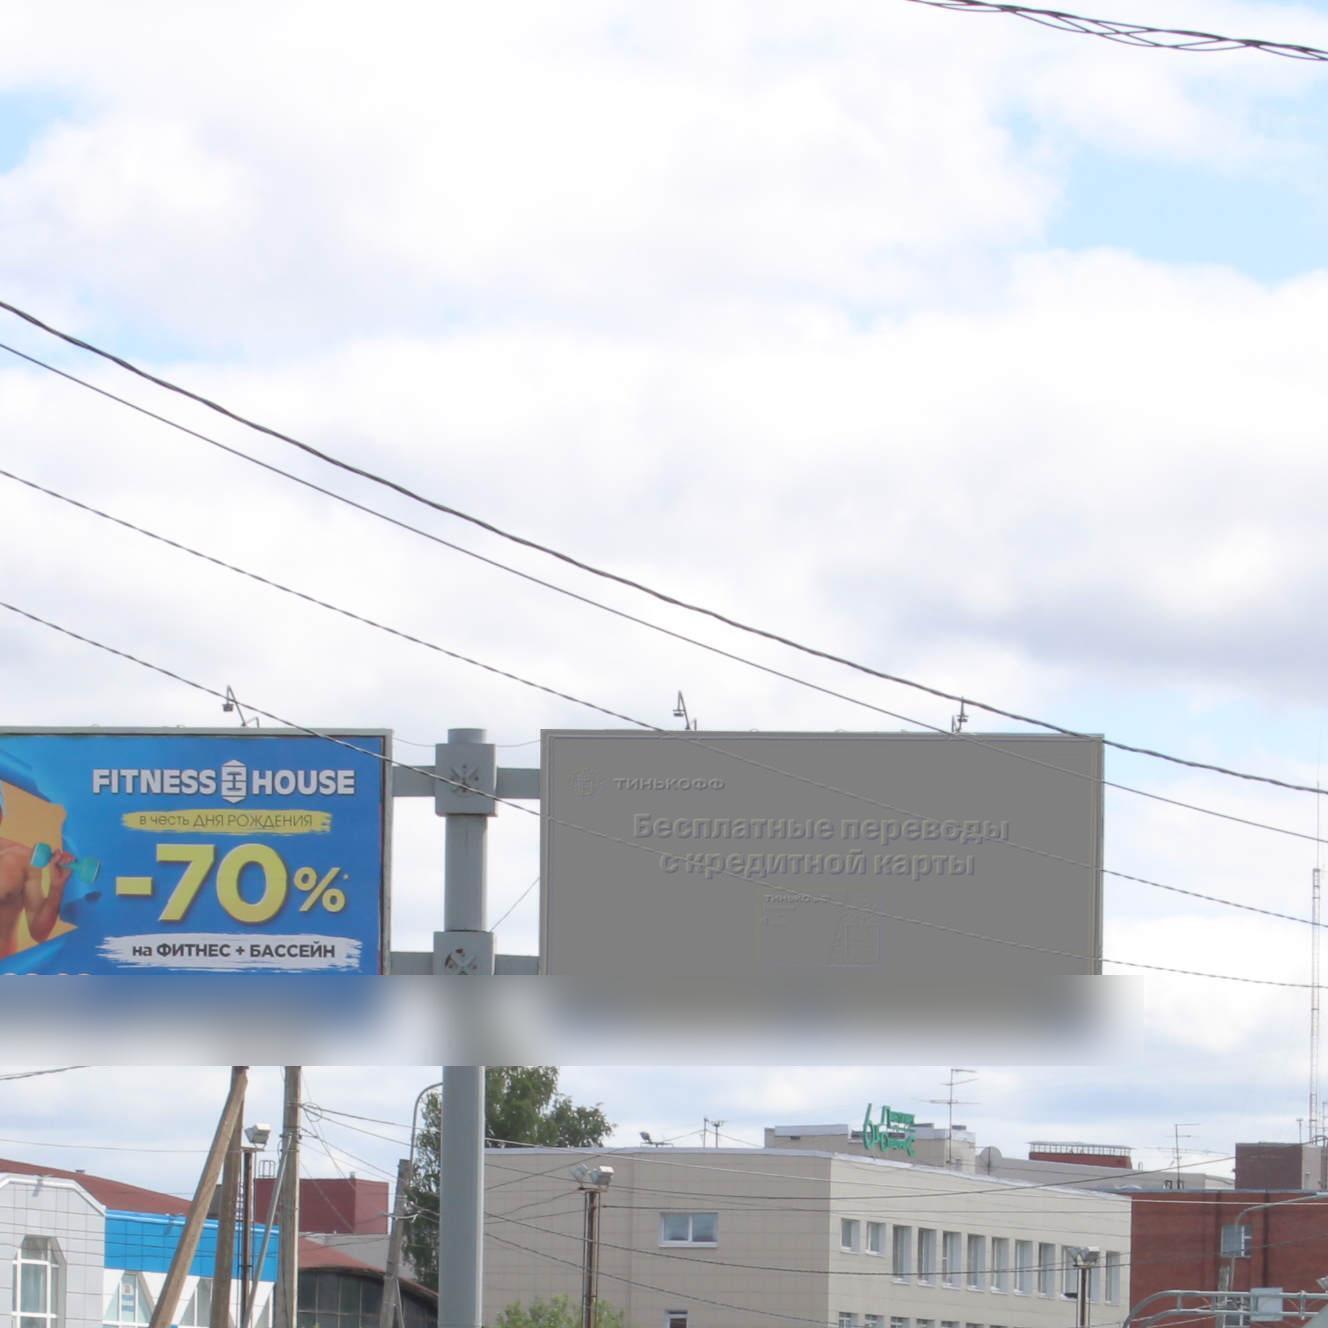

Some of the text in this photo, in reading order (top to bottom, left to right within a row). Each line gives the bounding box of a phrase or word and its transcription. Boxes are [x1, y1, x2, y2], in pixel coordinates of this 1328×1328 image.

[92, 769, 356, 795] FITNESS HOUSE
[613, 777, 726, 791] ТИНЬКОФФ
[150, 814, 190, 827] честь
[192, 814, 224, 828] ДНЯ
[227, 814, 313, 828] РОЖДЕНИЯ
[633, 813, 1010, 846] Бесплатные переводы
[686, 849, 867, 880] кредитной
[874, 853, 975, 881] карты
[132, 945, 153, 957] на
[156, 943, 231, 958] ФИТНЕС
[250, 941, 336, 958] БАССЕЙН
